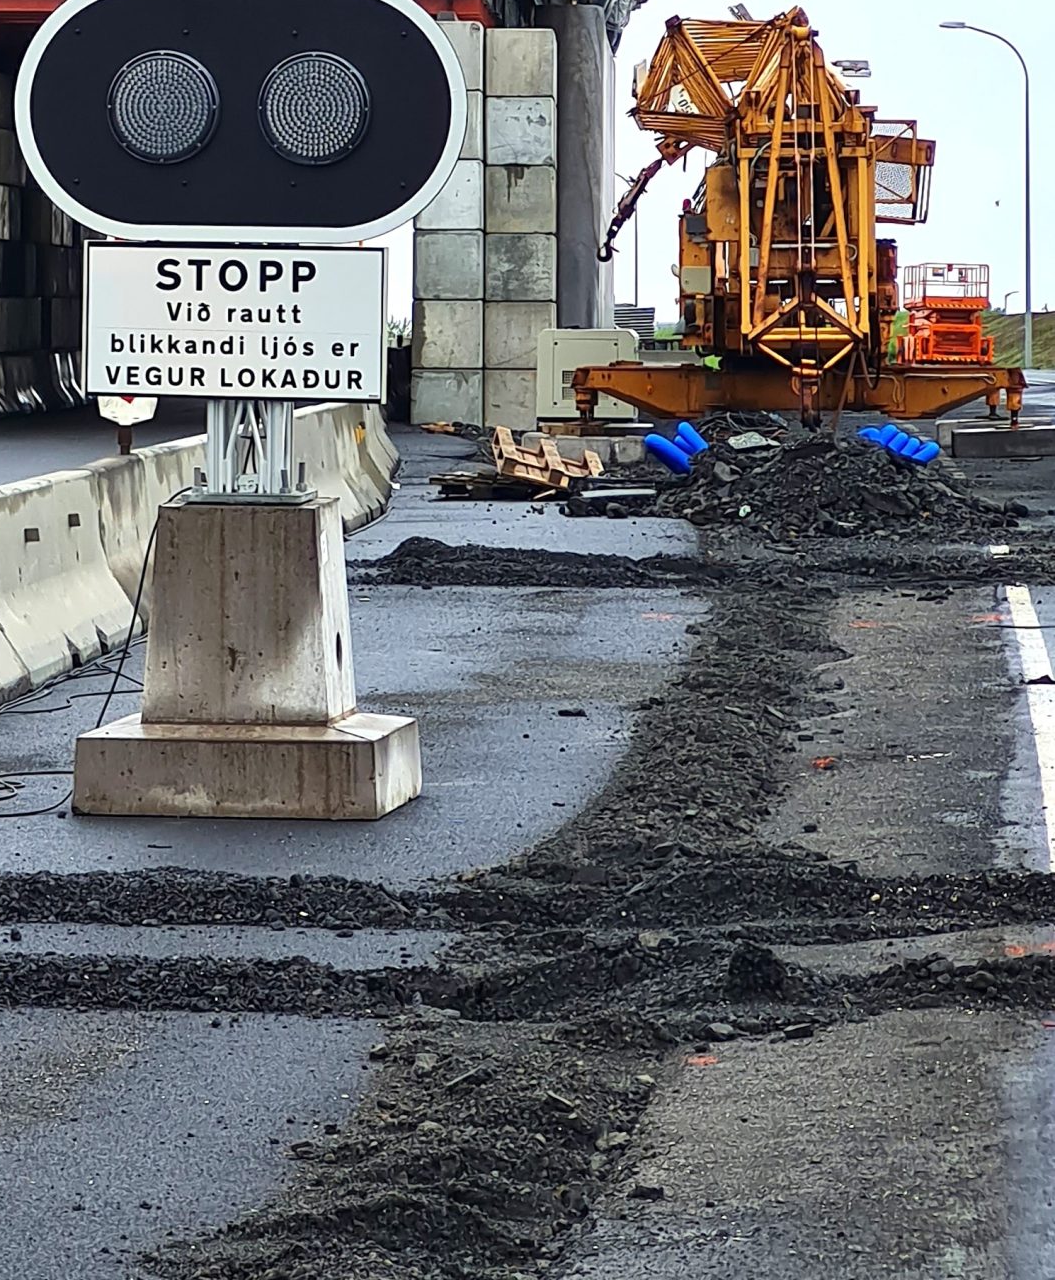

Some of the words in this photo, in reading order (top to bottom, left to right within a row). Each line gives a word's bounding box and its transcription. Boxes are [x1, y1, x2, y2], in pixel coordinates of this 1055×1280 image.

[155, 258, 317, 293] STOPP
[166, 301, 211, 322] Við
[227, 304, 302, 324] rautt
[110, 333, 245, 355] blikkandi
[261, 336, 314, 360] ljós
[331, 342, 360, 357] er
[105, 365, 205, 387] VEGUR
[220, 367, 363, 390] LOKAÐUR
